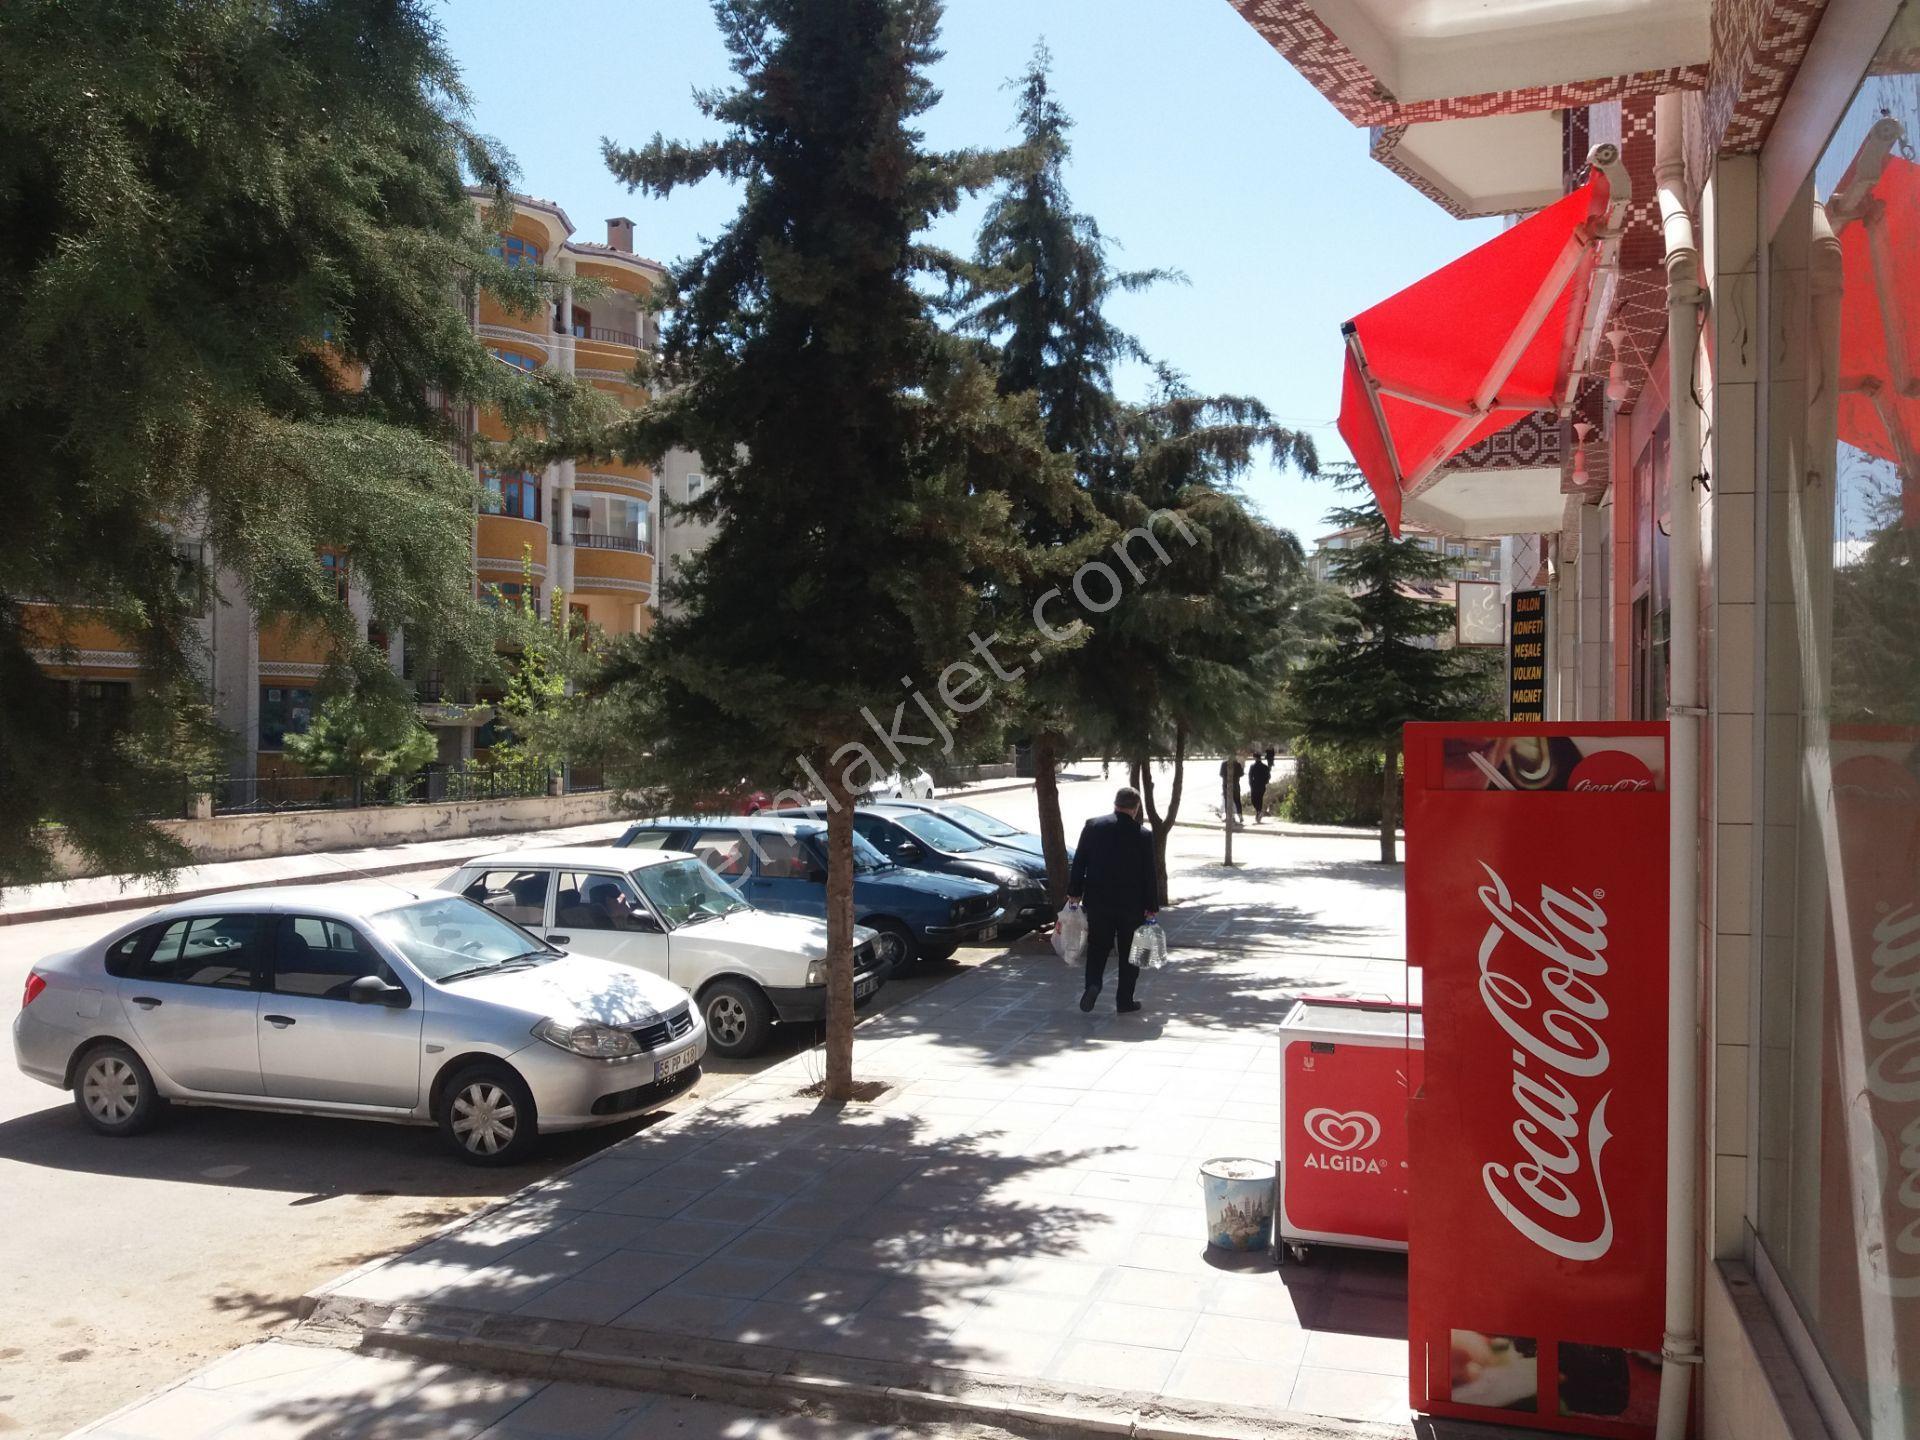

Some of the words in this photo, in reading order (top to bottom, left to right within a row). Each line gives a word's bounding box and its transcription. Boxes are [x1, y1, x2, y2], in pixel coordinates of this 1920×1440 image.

[1516, 597, 1541, 612] BALON
[1513, 616, 1544, 635] KONFETİ
[1514, 643, 1542, 660] MEŞALE
[1513, 666, 1542, 681] VOLKAN
[1512, 688, 1542, 703] MAGNET
[1477, 859, 1613, 1262] Coca-Cola
